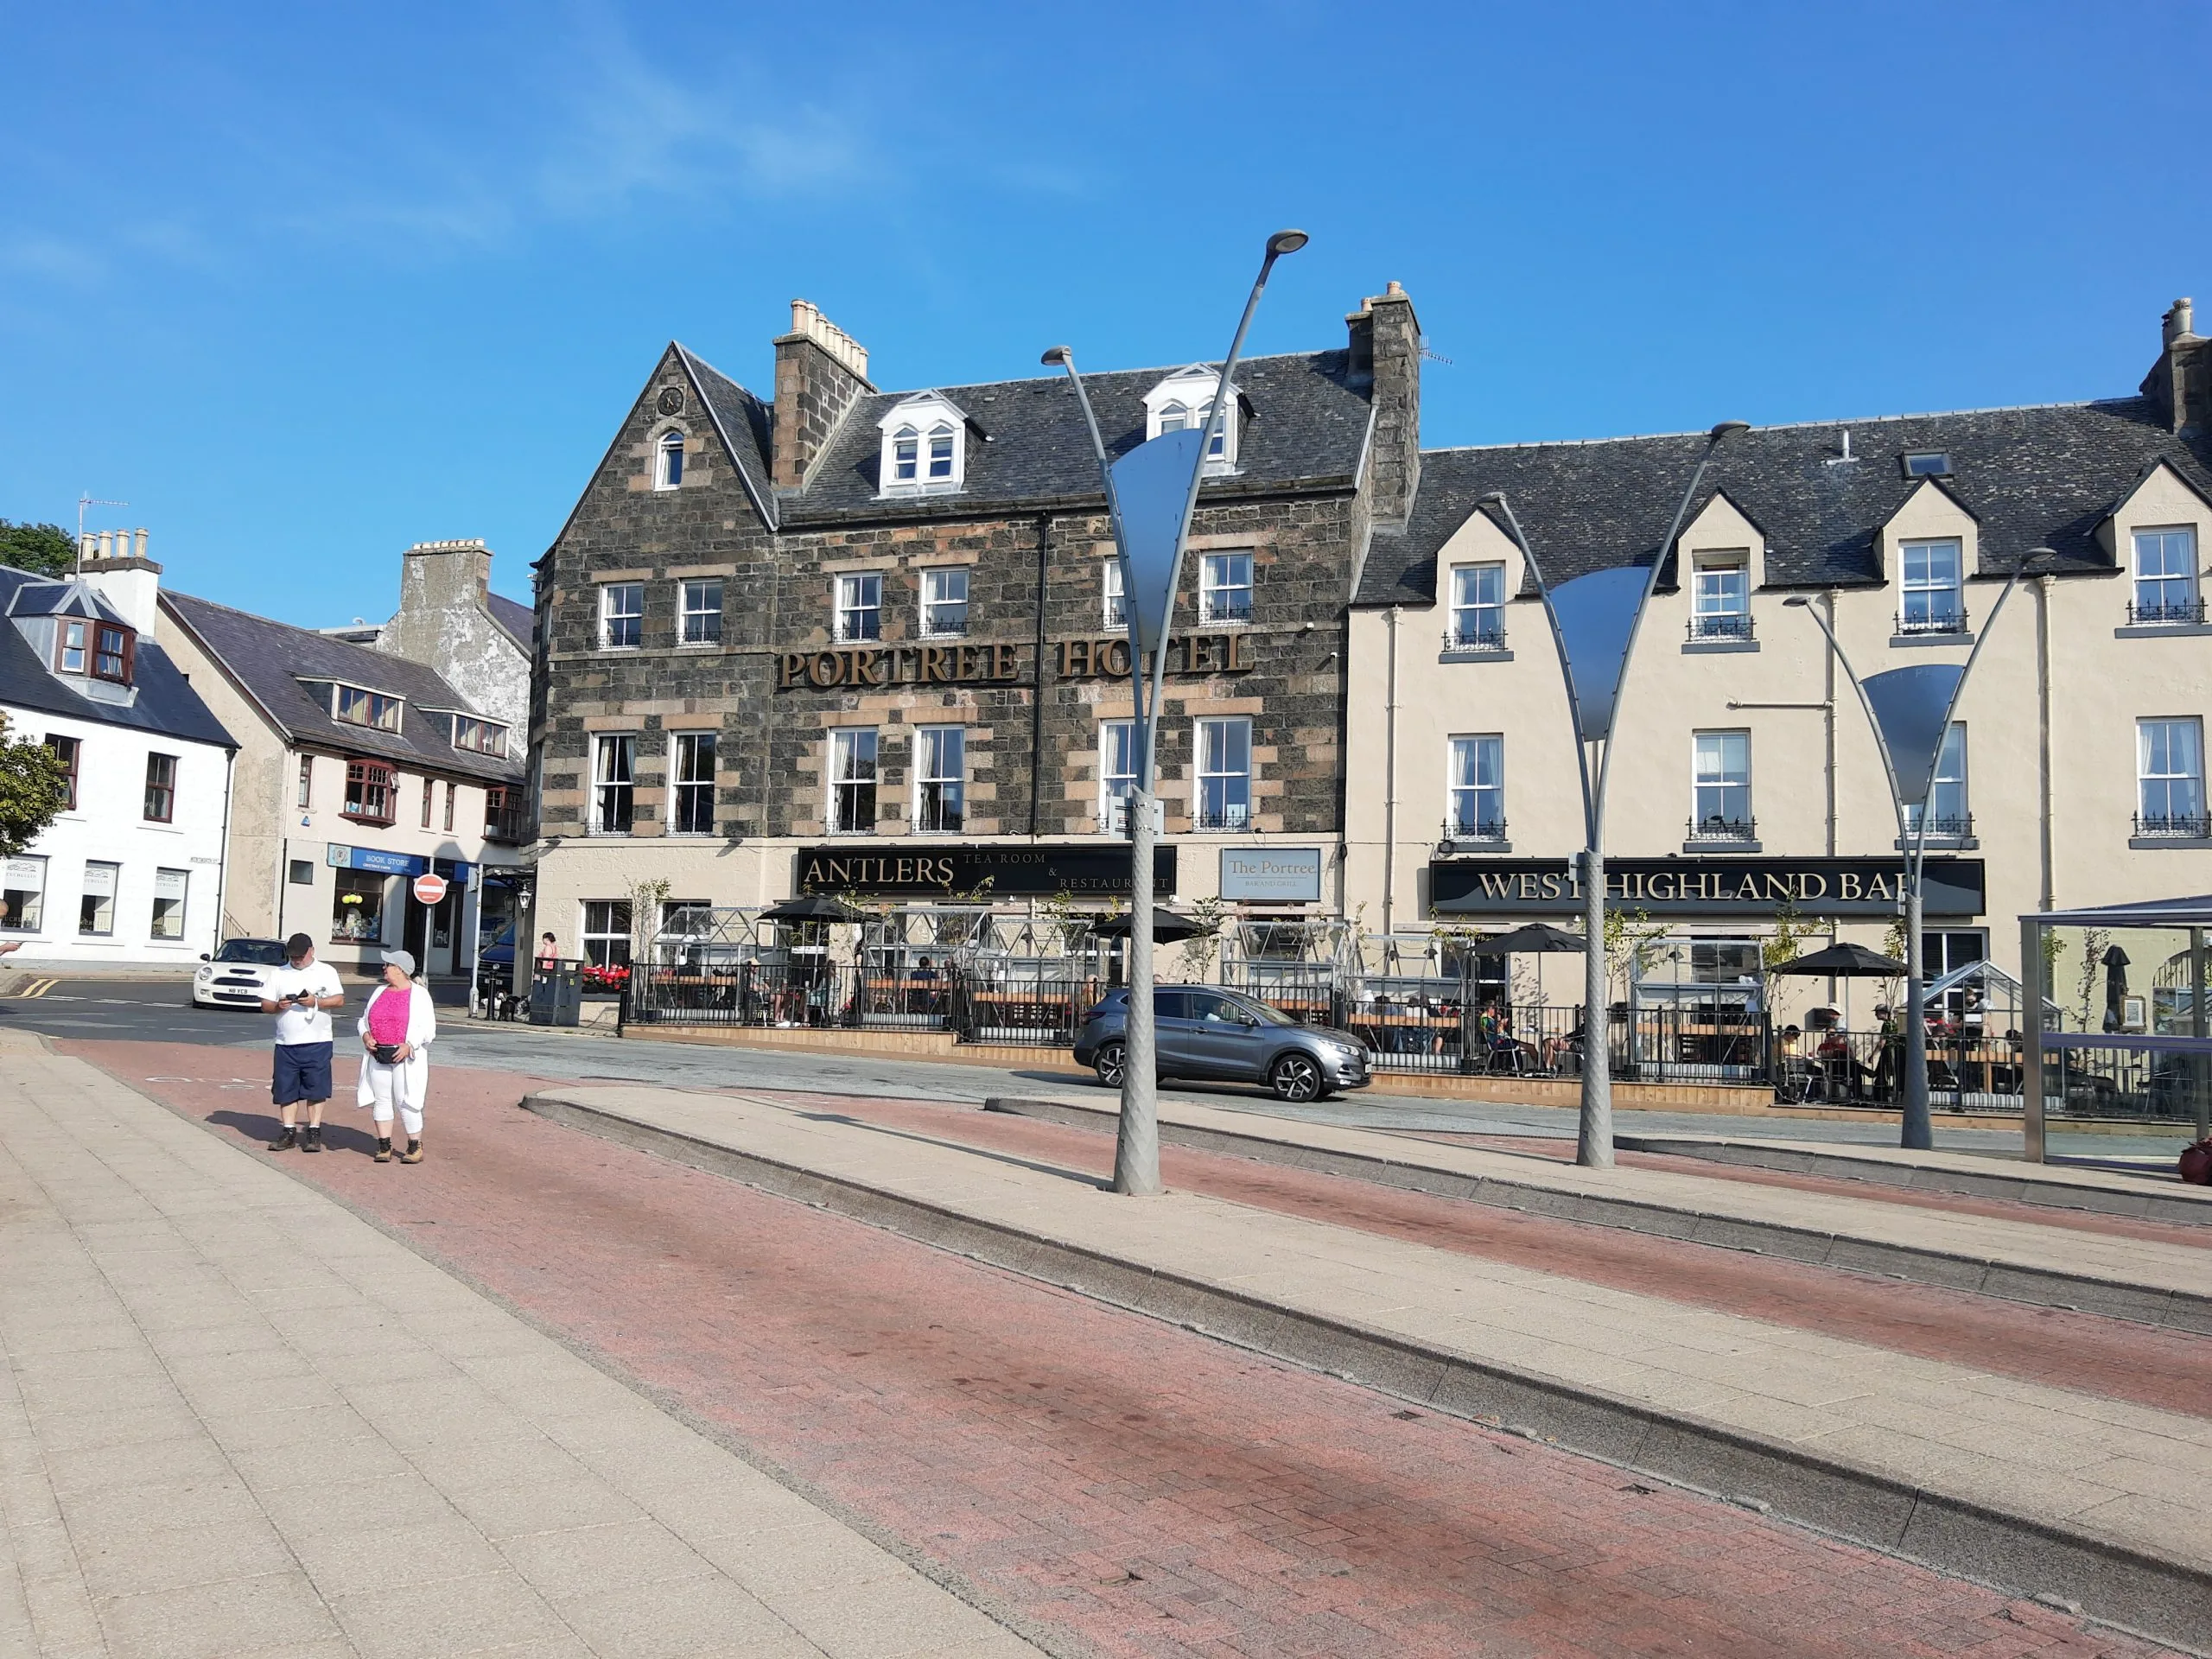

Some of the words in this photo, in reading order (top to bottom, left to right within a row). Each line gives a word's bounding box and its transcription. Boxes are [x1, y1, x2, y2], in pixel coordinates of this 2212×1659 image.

[778, 643, 1020, 689] PORTREE
[1058, 633, 1255, 677] HOEL
[365, 855, 385, 864] BOOK
[387, 857, 410, 867] STORE
[963, 854, 993, 864] TEA
[1000, 854, 1046, 864] ROOM
[804, 857, 954, 883] ANTLERS
[1048, 867, 1058, 877] &
[1229, 860, 1257, 874] The
[1261, 860, 1317, 874] Portree
[1059, 878, 1168, 889] RESTAURT
[1478, 872, 1583, 900] WEST
[1601, 872, 1827, 900] HIGHLAND
